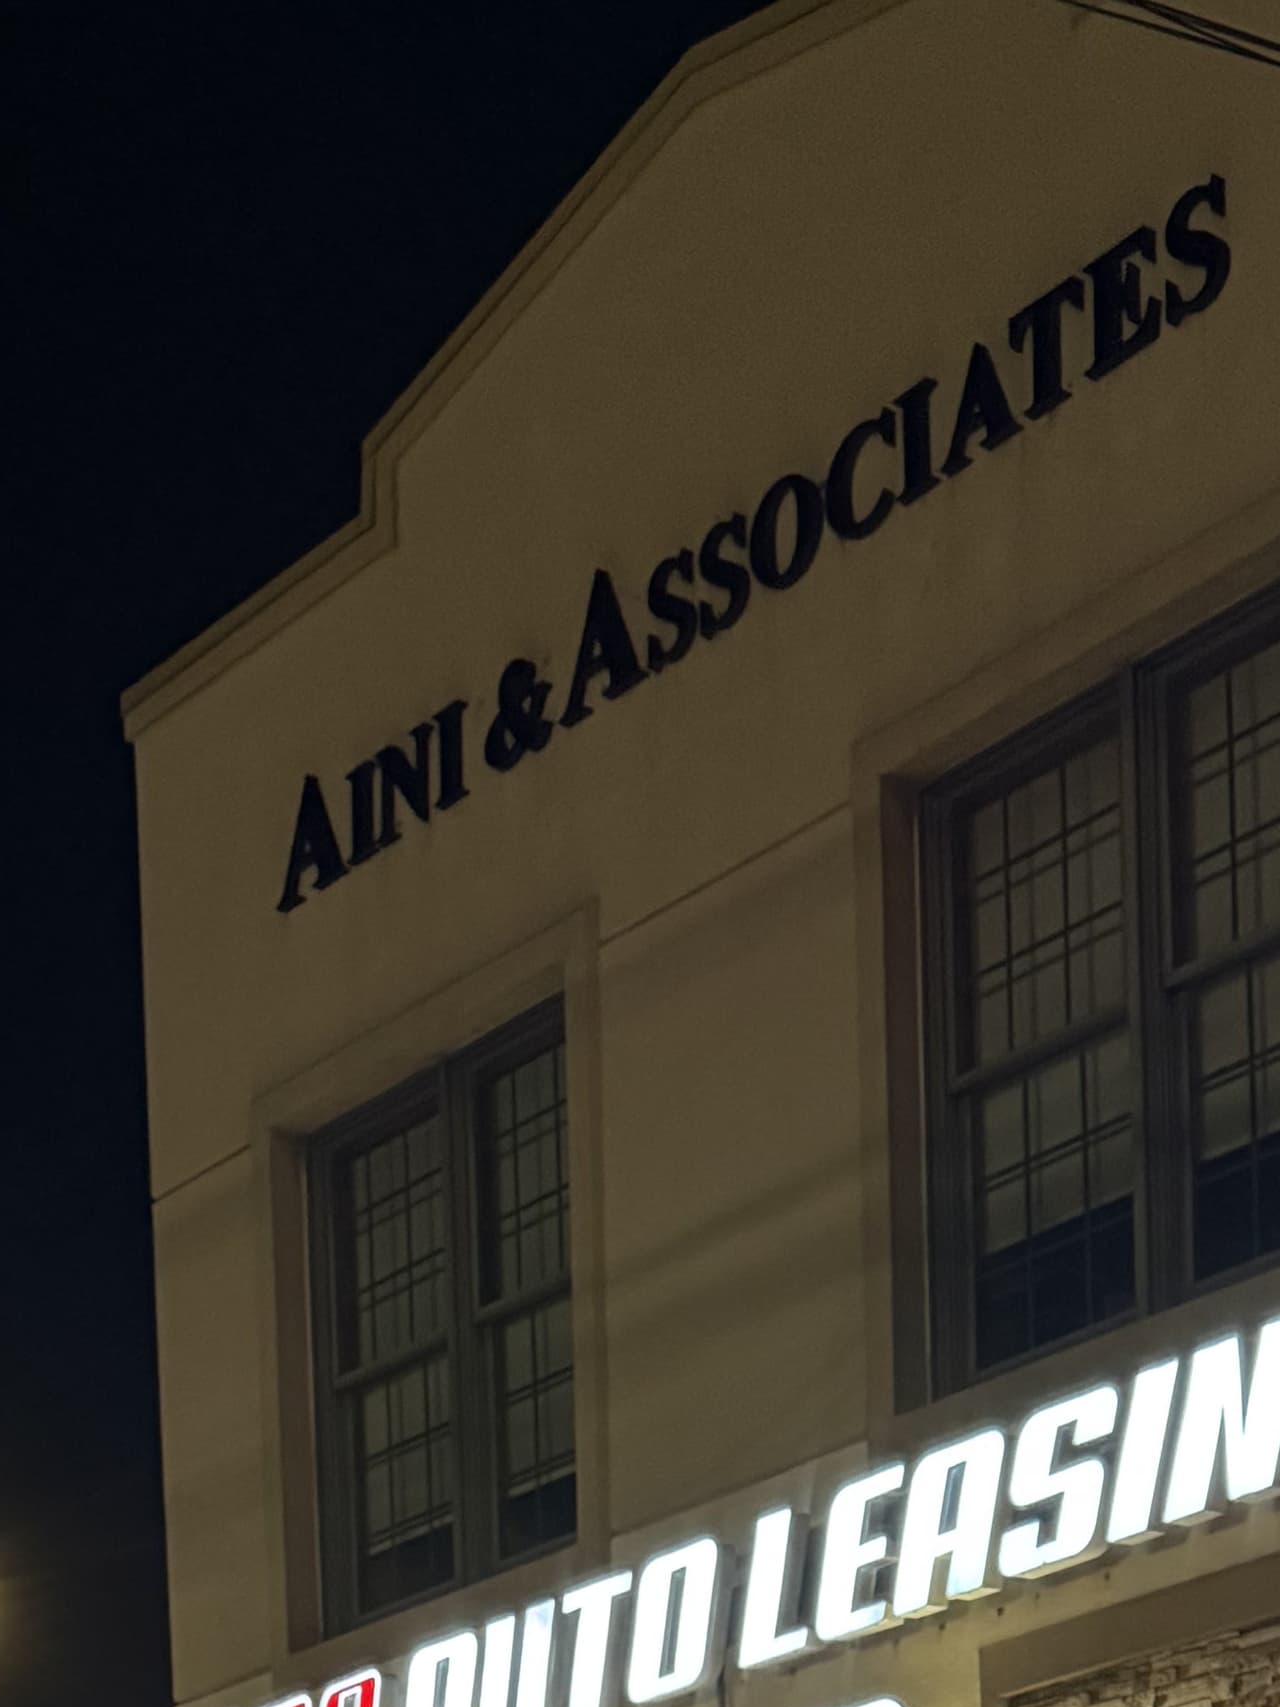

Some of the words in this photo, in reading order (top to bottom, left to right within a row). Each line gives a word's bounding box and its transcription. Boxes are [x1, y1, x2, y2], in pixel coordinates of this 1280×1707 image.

[276, 699, 470, 914] AINI
[482, 656, 556, 774] &
[559, 173, 1233, 728] ASSOCIATES
